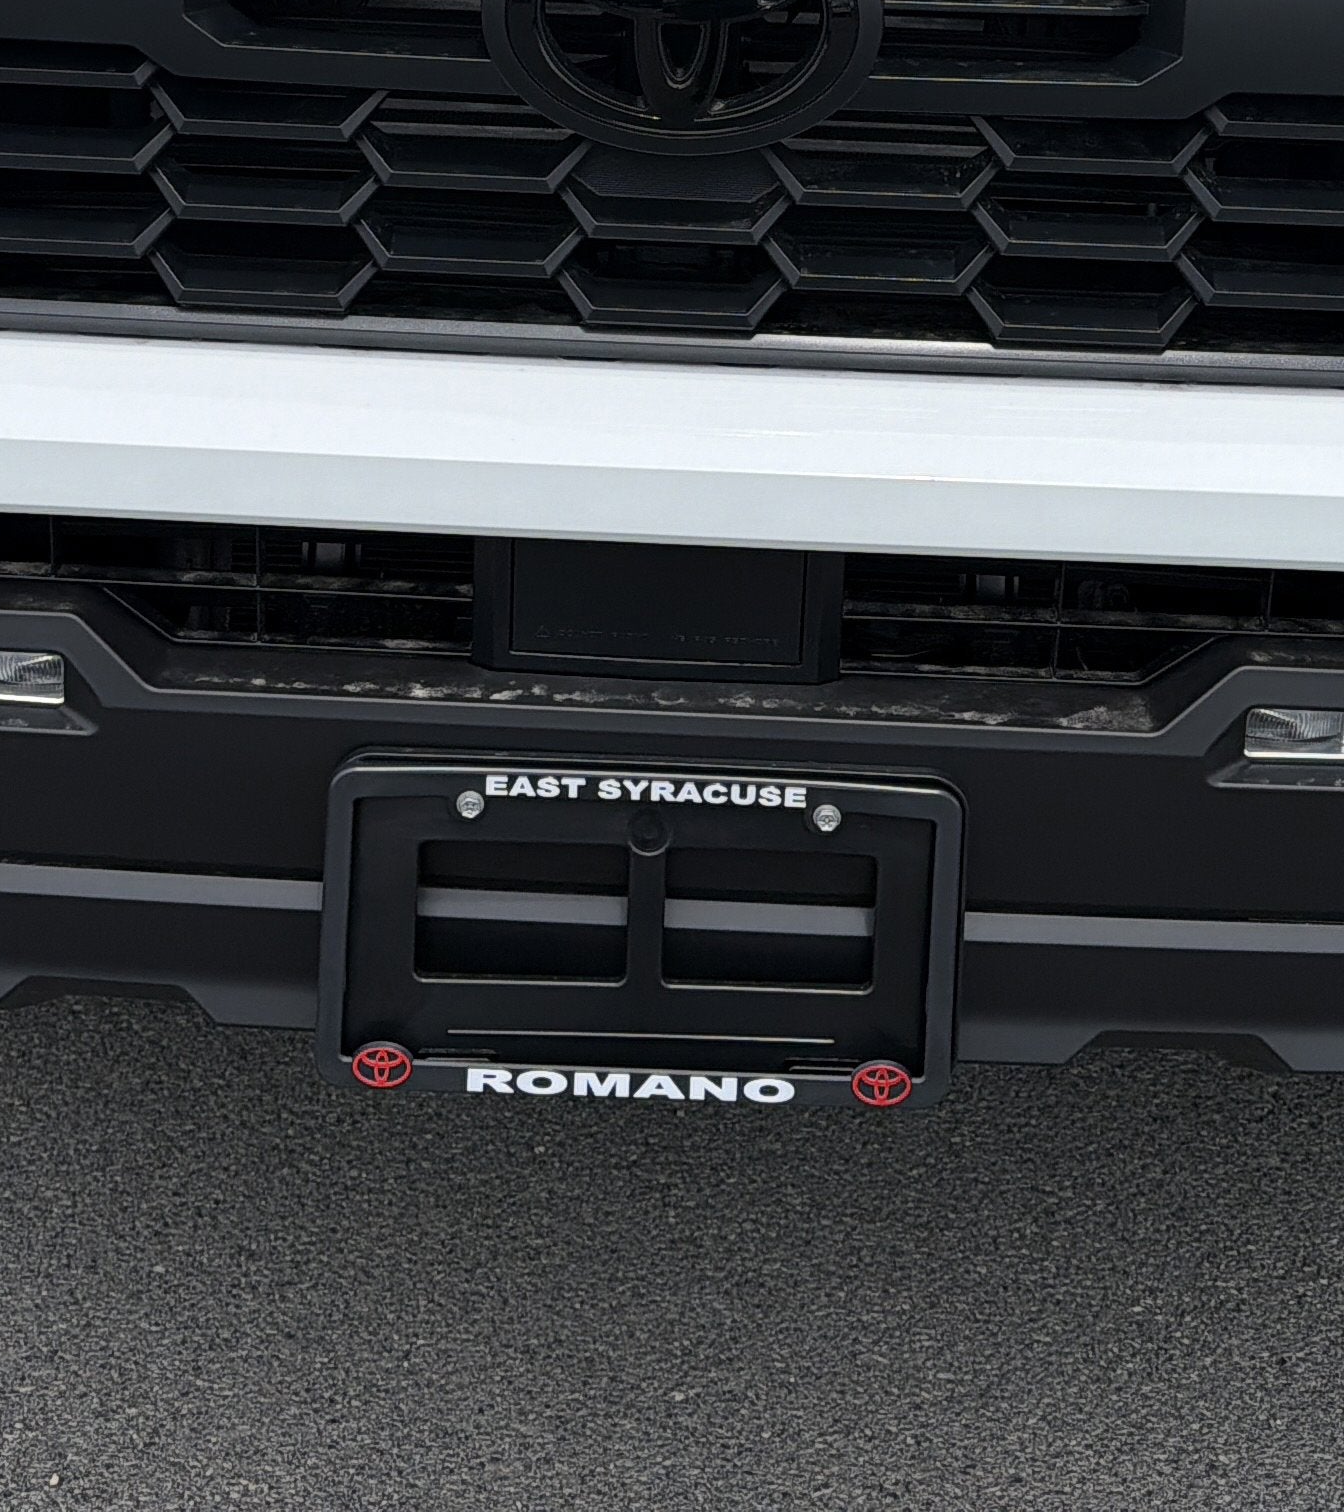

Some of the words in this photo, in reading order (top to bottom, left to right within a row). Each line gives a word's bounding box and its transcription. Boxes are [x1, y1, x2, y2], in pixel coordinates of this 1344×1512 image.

[485, 774, 586, 799] EAST
[597, 778, 807, 809] SYRACUSE
[466, 1068, 795, 1103] ROMANO
